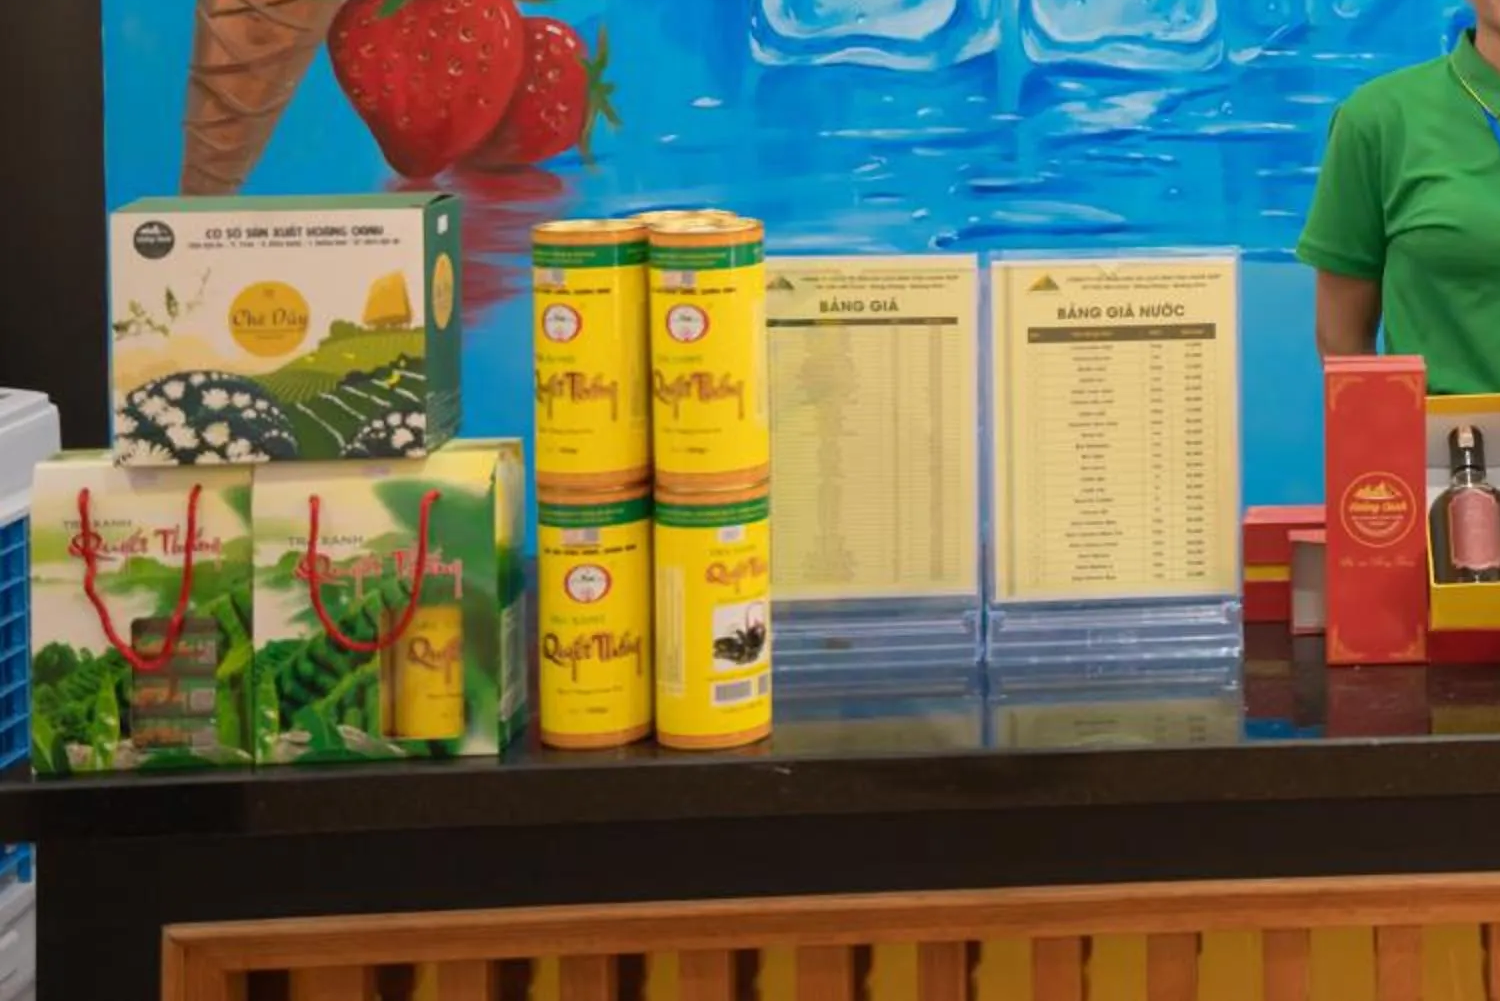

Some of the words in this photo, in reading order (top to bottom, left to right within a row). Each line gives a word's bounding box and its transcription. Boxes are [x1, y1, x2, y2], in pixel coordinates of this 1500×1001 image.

[819, 296, 865, 313] BẢNG
[870, 296, 899, 312] GIÁ
[1057, 302, 1102, 320] BẢNG
[1106, 302, 1135, 319] GIÁ
[1140, 301, 1185, 318] NƯỚC
